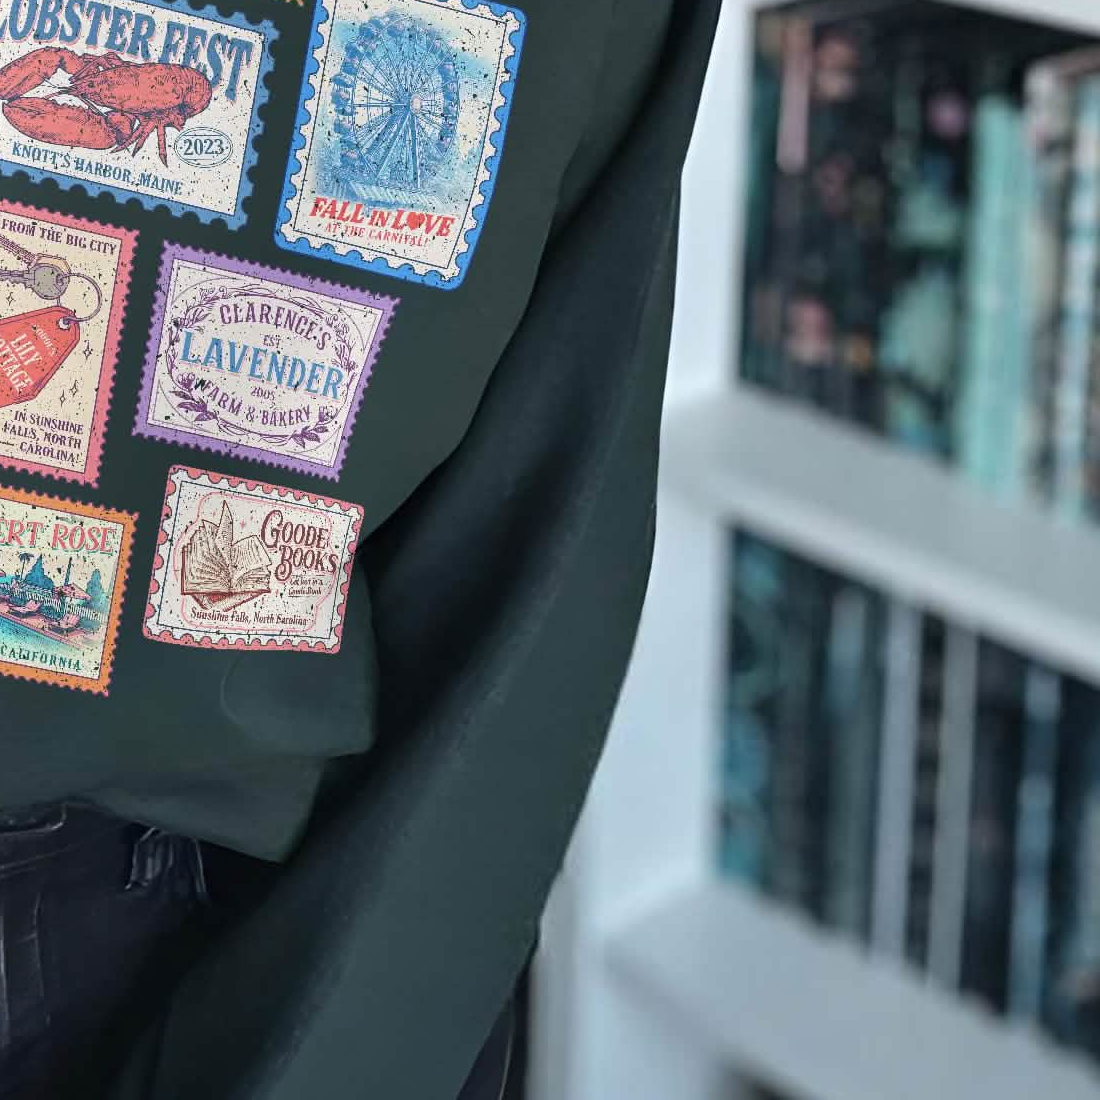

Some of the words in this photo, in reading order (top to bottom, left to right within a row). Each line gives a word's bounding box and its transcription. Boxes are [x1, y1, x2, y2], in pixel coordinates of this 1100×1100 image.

[158, 21, 254, 101] FEST
[183, 139, 224, 157] 2023
[11, 141, 71, 168] KNOTT'S
[74, 158, 136, 185] HARBOR,
[139, 173, 184, 196] MAINE
[309, 197, 364, 223] FALL
[368, 209, 391, 227] IN
[1, 219, 36, 237] FROM
[39, 227, 63, 243] THE
[66, 234, 87, 250] BIG
[89, 240, 118, 256] CITY
[325, 222, 341, 234] AT
[344, 225, 365, 238] THE
[219, 303, 332, 351] CLARENCE'S
[179, 330, 345, 401] LAVENDER
[202, 379, 243, 416] FARM
[246, 406, 256, 422] &
[261, 404, 310, 427] BAKERY
[2, 422, 39, 440] FALLS,
[43, 431, 82, 449] NORTH
[14, 410, 26, 423] IN
[28, 413, 84, 435] SUNSHINE
[19, 441, 83, 464] CAROLINA!
[50, 524, 116, 554] ROSE
[261, 509, 328, 548] GOODE
[275, 545, 338, 581] BOOKS
[0, 644, 82, 671] CALIFORNIA
